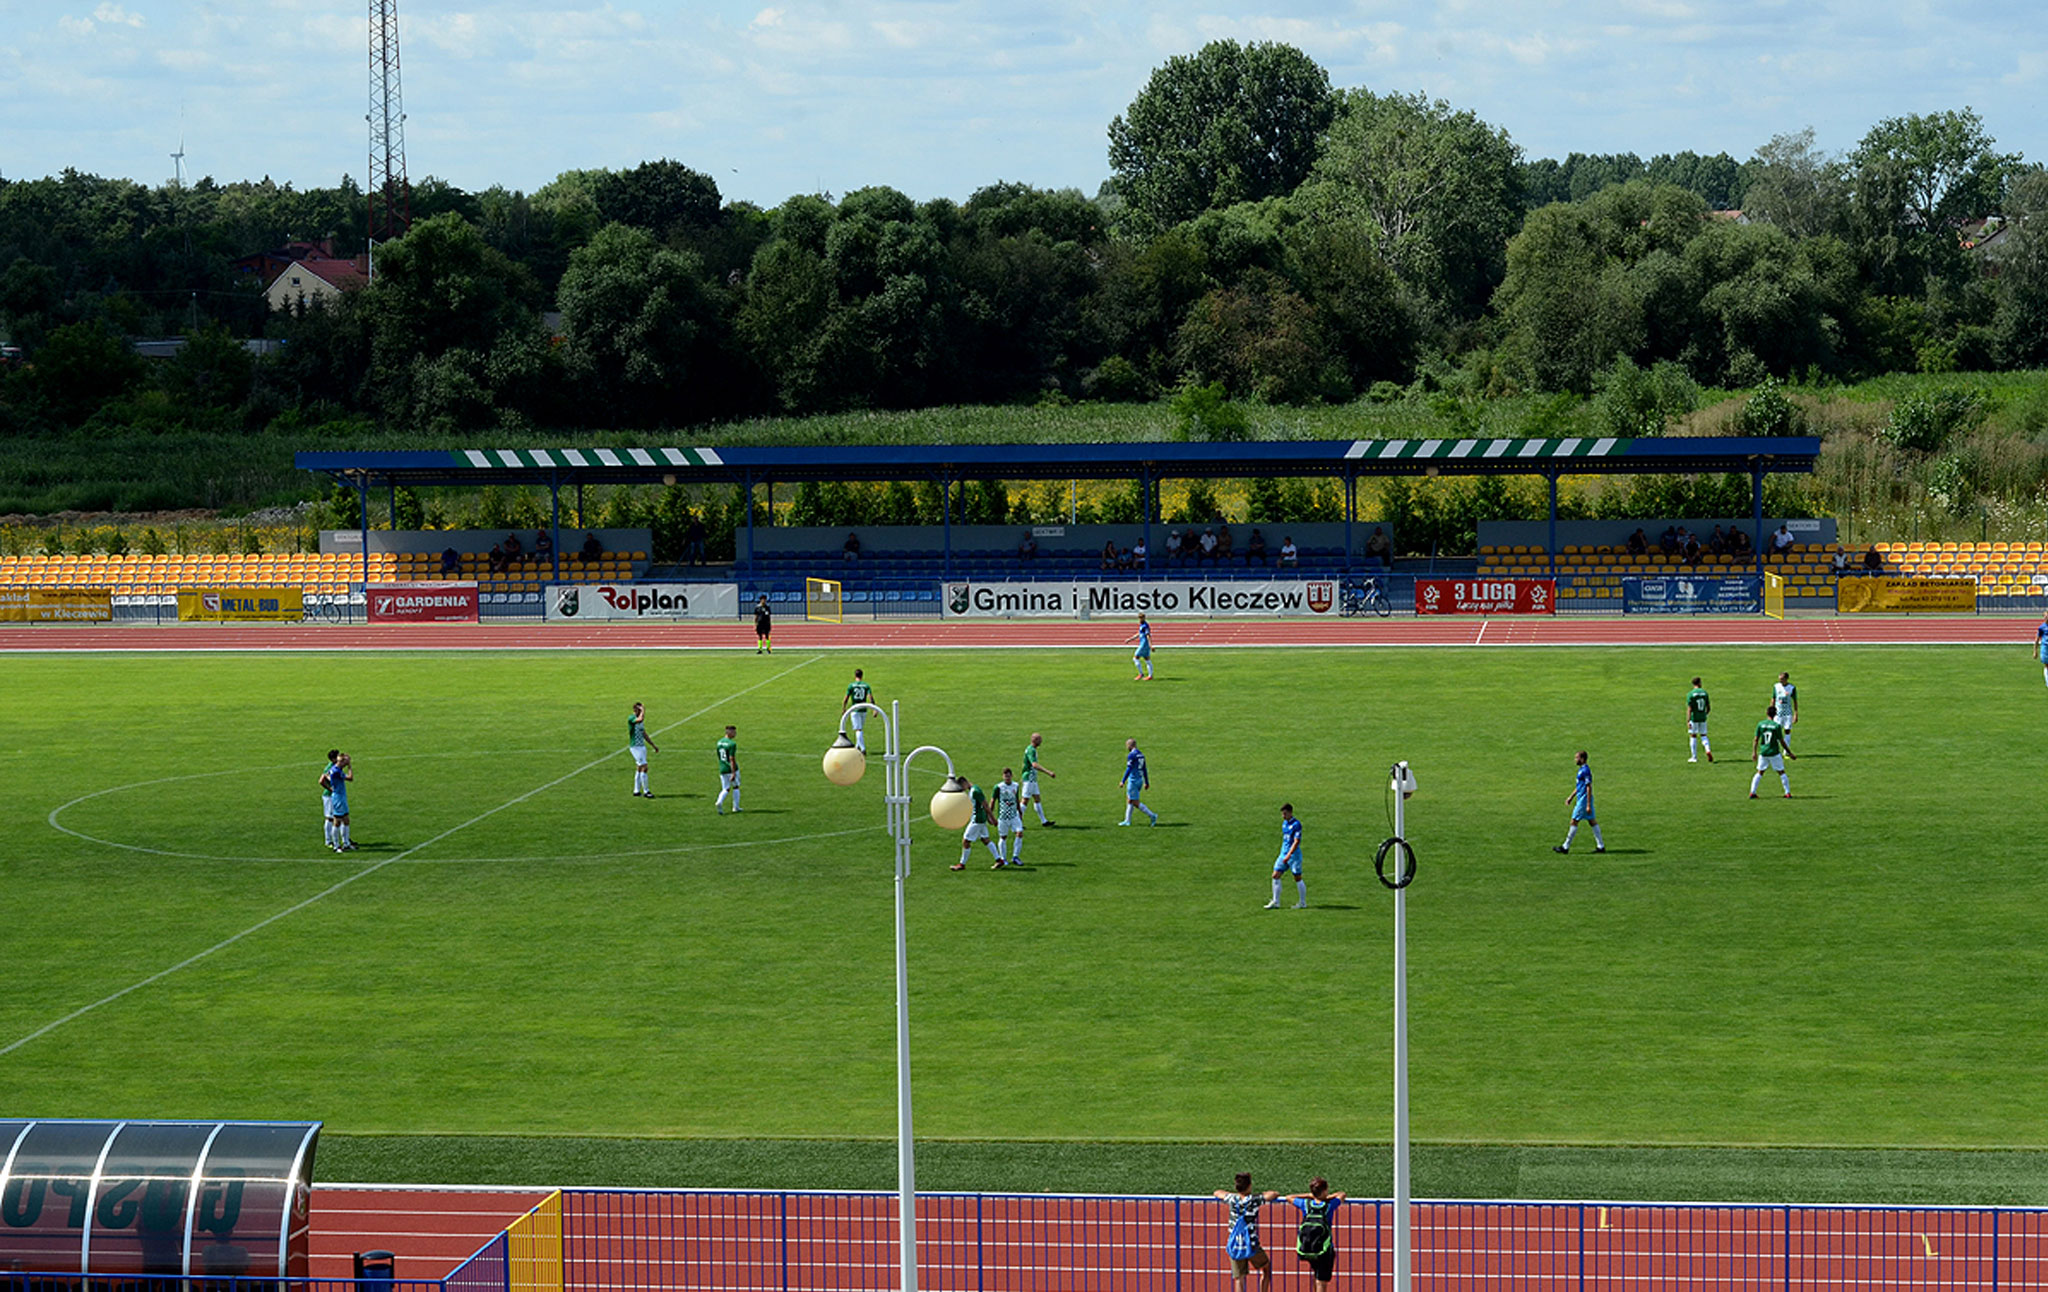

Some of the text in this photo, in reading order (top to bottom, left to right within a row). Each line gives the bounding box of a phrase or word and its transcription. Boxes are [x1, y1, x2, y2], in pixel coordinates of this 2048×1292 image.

[395, 596, 468, 607] GARDENIA
[597, 587, 688, 615] Rolplan
[974, 586, 1303, 610] Gmina i Miasto Kleczew
[1454, 583, 1516, 600] 3 LIGA
